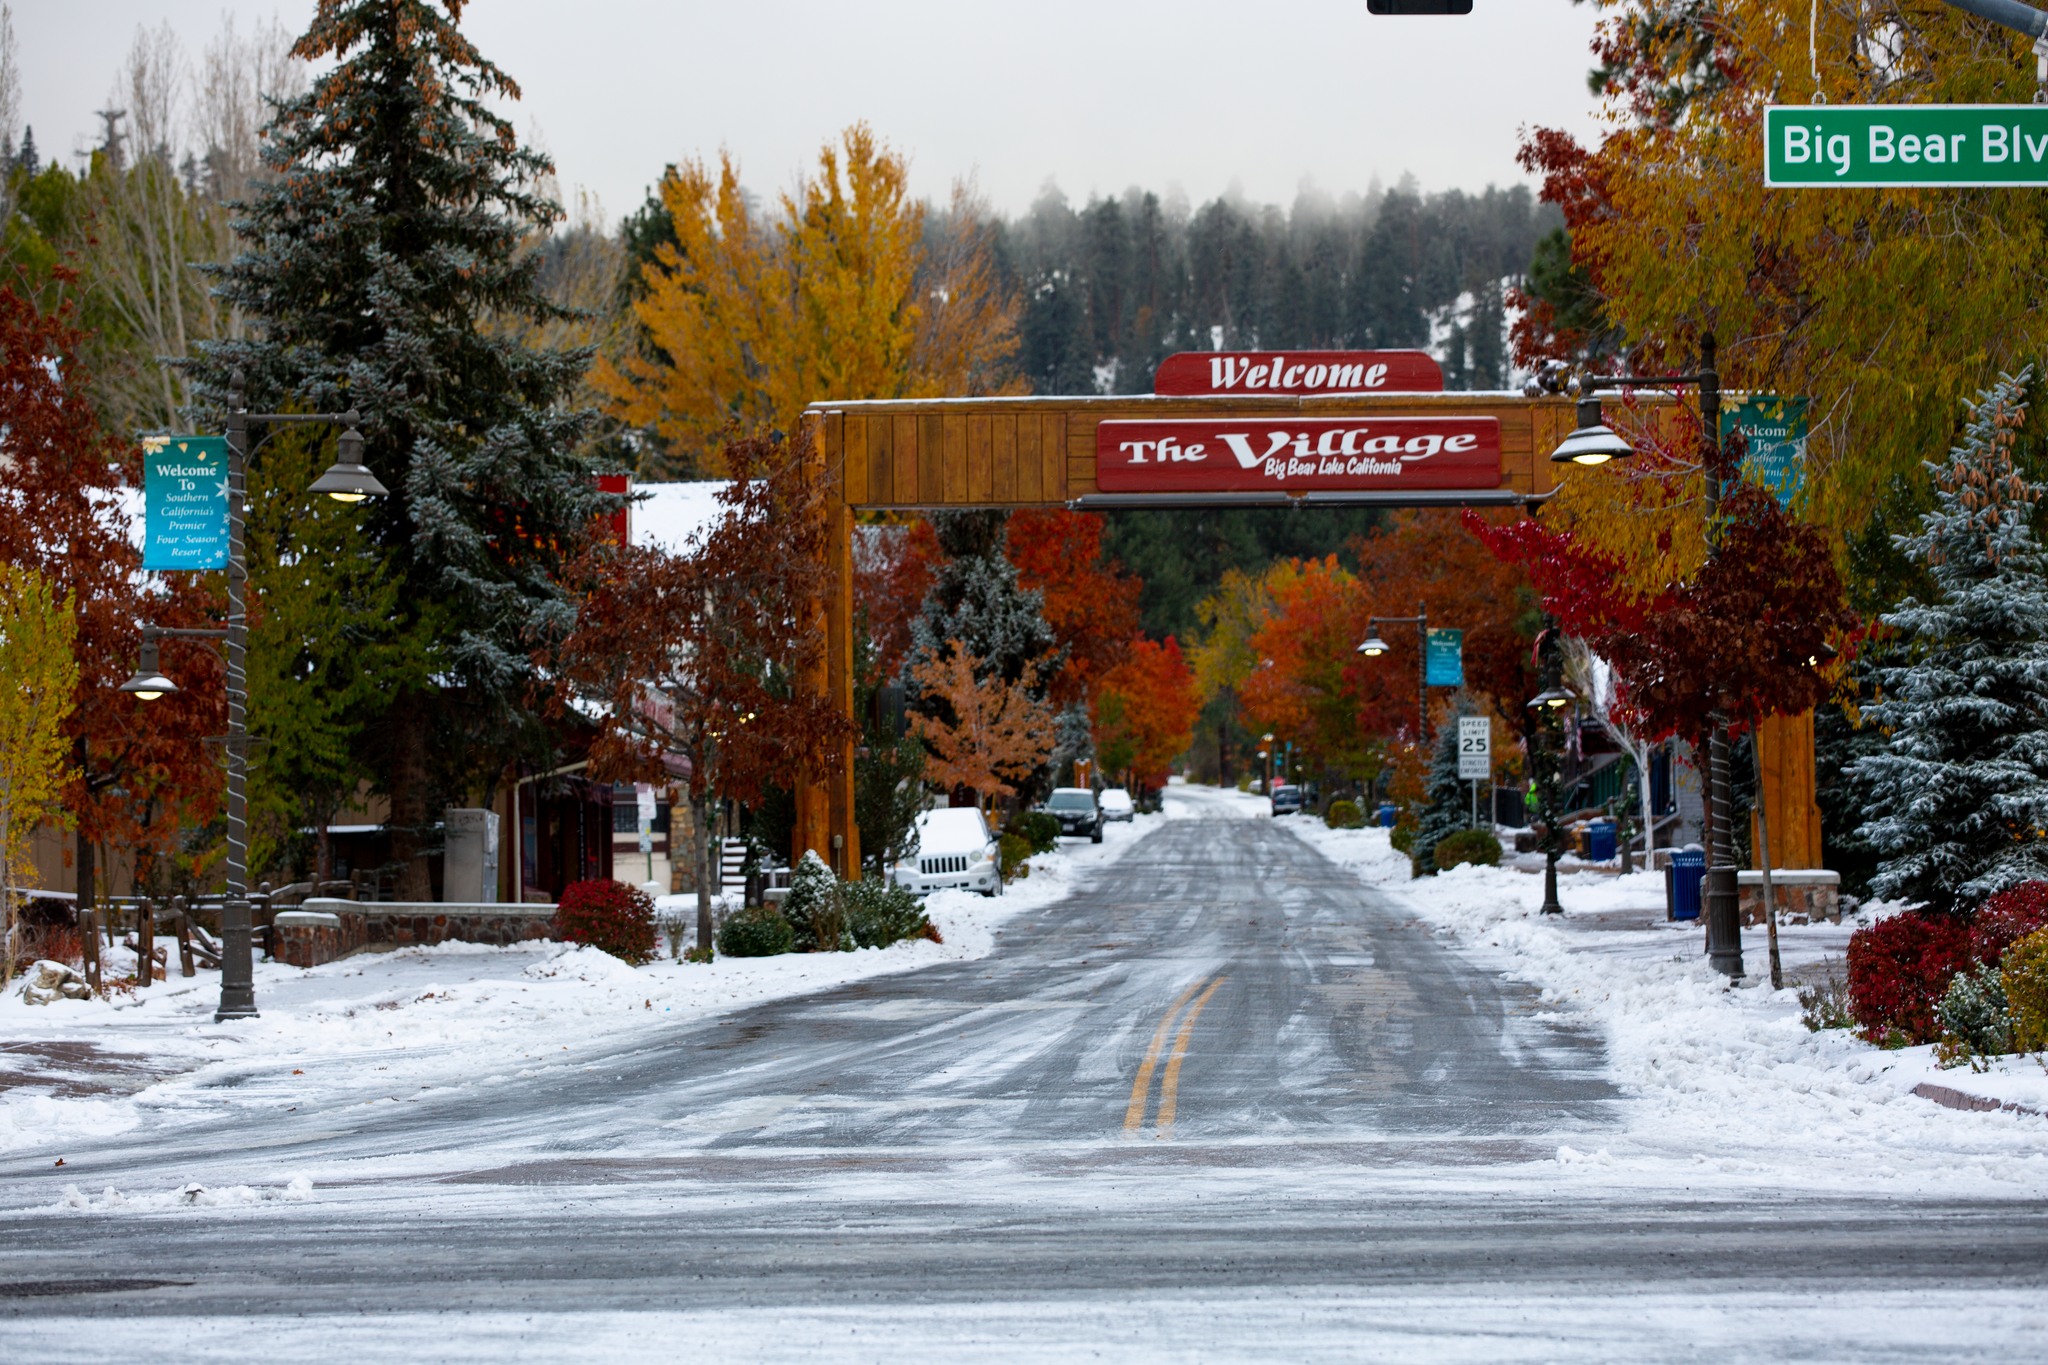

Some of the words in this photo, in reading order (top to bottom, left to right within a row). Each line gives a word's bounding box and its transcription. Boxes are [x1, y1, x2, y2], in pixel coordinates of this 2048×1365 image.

[1784, 125, 1850, 176] Big
[1869, 125, 1966, 163] Bear
[1209, 357, 1388, 389] Welcome
[1732, 424, 1792, 437] Welcom
[1119, 436, 1208, 463] The
[1214, 428, 1479, 469] Village
[156, 464, 217, 477] Welcome
[1264, 457, 1286, 480] Big
[1287, 457, 1316, 476] Bear
[1318, 456, 1345, 475] Lake
[1346, 456, 1402, 475] California
[178, 478, 196, 491] To
[165, 493, 209, 503] Southern
[160, 506, 214, 519] California's
[168, 521, 207, 531] Premier
[156, 535, 179, 545] Four
[171, 548, 202, 557] Resort
[1461, 720, 1488, 728] SPEED
[1462, 738, 1487, 753] 25
